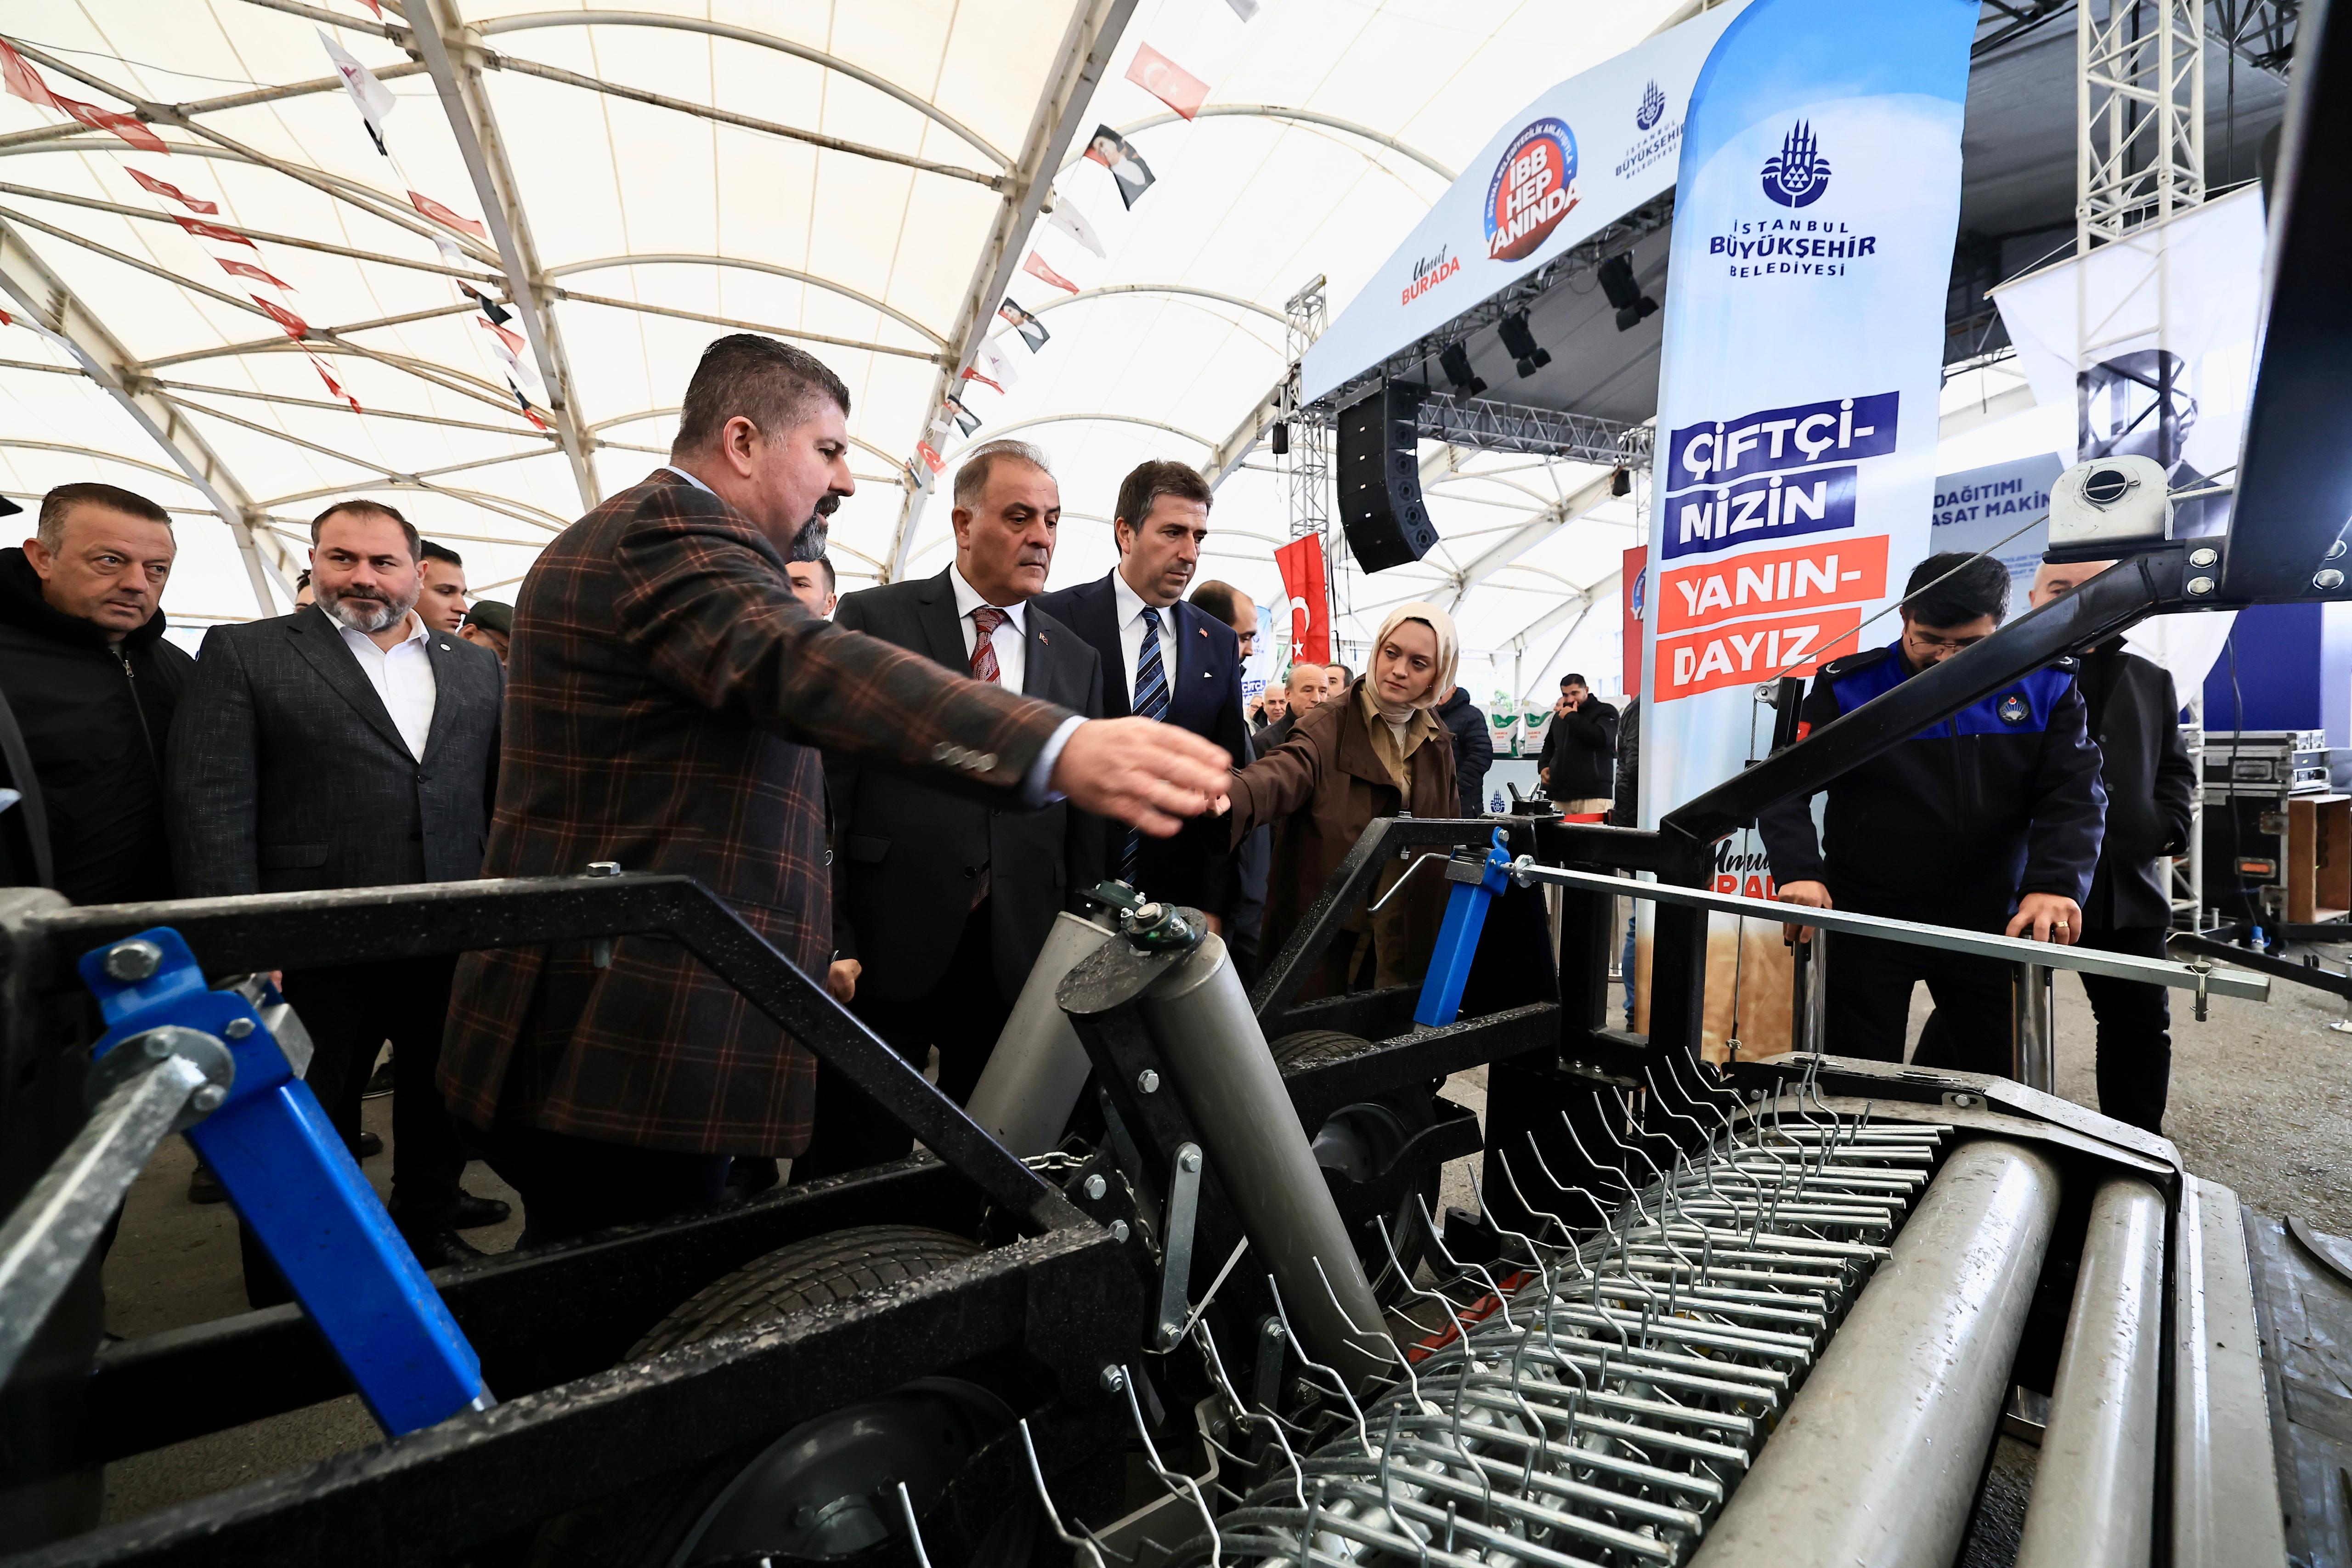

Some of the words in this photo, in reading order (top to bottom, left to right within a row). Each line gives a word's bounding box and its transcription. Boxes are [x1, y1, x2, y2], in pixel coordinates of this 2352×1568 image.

[1510, 144, 1548, 192] İBB
[1484, 177, 1582, 257] YANINDA
[1506, 167, 1553, 220] HEP
[1710, 234, 1876, 259] BÜYÜKŞEHİR
[1734, 219, 1849, 234] İSTANBUL
[1402, 256, 1460, 306] BURADA
[1413, 243, 1447, 282] Umut
[1730, 261, 1845, 278] BELEDİYESİ
[1682, 398, 1875, 481] ÇİFTÇİ-
[1679, 475, 1828, 545] MİZİN
[1934, 478, 2023, 508] DAĞITIMI
[1675, 554, 1862, 617] YANIN-
[1673, 624, 1820, 687] DAYIZ
